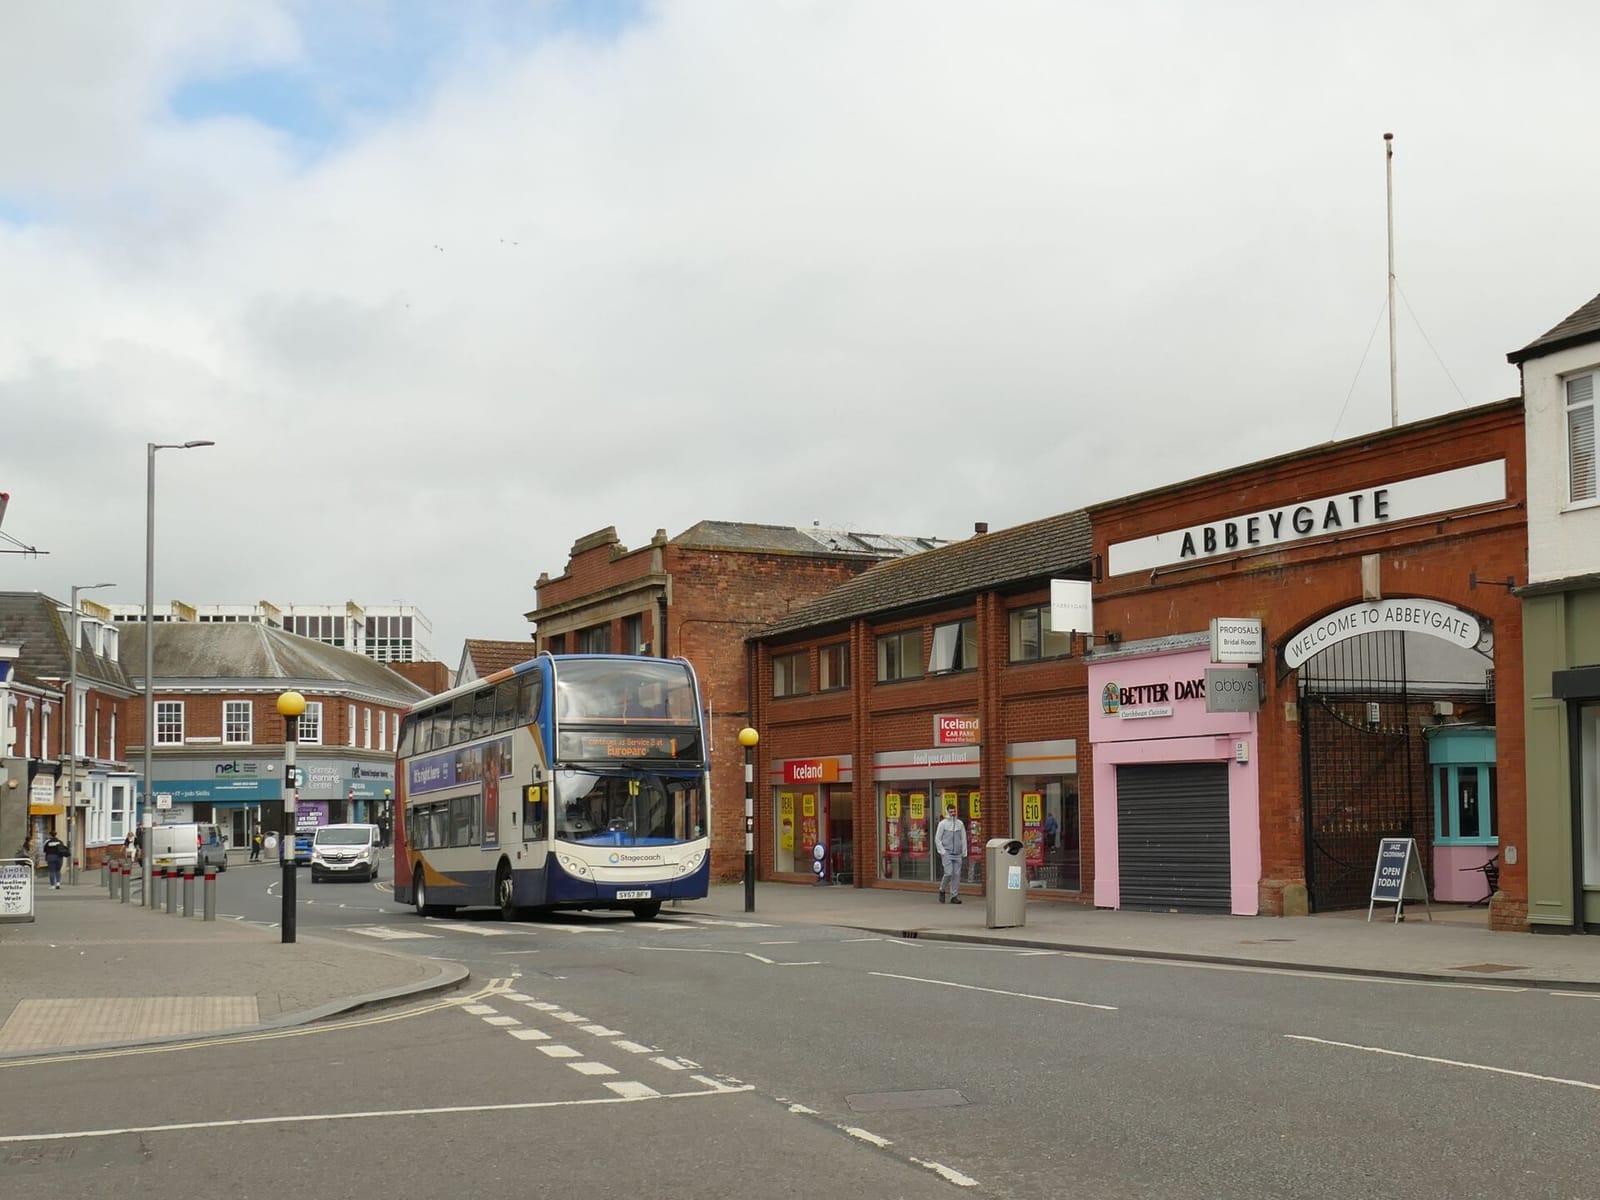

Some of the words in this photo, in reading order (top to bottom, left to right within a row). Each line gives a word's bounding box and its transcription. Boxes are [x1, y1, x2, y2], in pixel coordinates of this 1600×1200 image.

[1180, 489, 1389, 558] ABBEYGATE
[1220, 626, 1260, 635] PROPOSALS
[1291, 612, 1358, 658] WELCOME
[1361, 609, 1380, 625] TO
[1384, 607, 1470, 639] ABBEYGATE
[1223, 638, 1240, 646] Bridal
[1214, 677, 1254, 695] abbys
[1119, 683, 1169, 706] BETTER
[1174, 679, 1206, 701] DAYS
[1121, 710, 1148, 718] Caribbean
[941, 719, 979, 730] Iceland
[607, 745, 648, 756] Europarc
[671, 738, 678, 758] 1
[216, 761, 241, 774] net
[308, 767, 338, 775] Grimsby
[793, 763, 823, 779] Iceland
[309, 774, 340, 783] Learning
[308, 782, 332, 790] Centre
[1025, 804, 1039, 819] £10
[620, 854, 661, 862] Stagecoach
[1382, 867, 1401, 876] OPEN
[1378, 879, 1401, 887] TODAY
